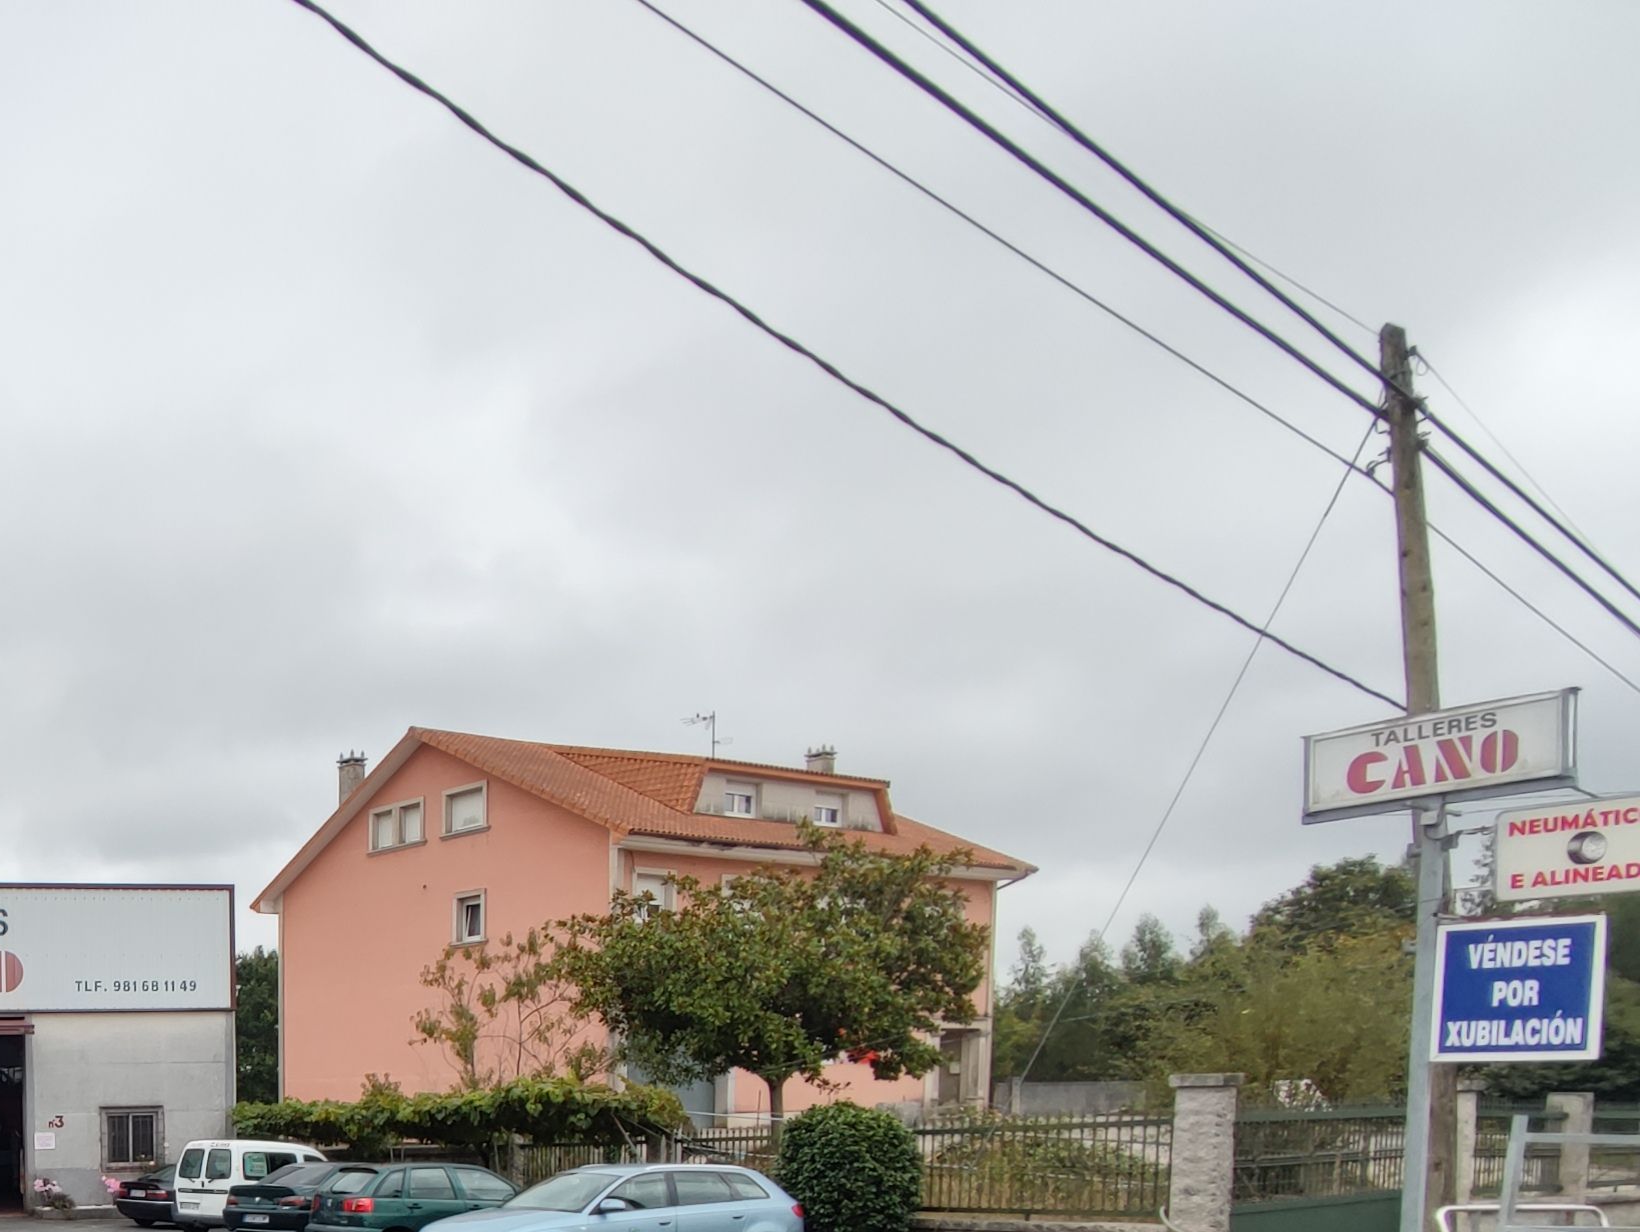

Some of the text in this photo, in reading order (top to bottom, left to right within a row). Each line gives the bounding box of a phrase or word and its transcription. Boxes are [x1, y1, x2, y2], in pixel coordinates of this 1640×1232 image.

[1371, 712, 1497, 747] TALLERES
[1346, 729, 1520, 794] CANO
[1510, 874, 1525, 889] E
[1469, 934, 1572, 969] VÉNDESE
[74, 980, 108, 992] TLF.
[1492, 979, 1540, 1007] POR
[1445, 1009, 1583, 1047] XUBILACIÓN
